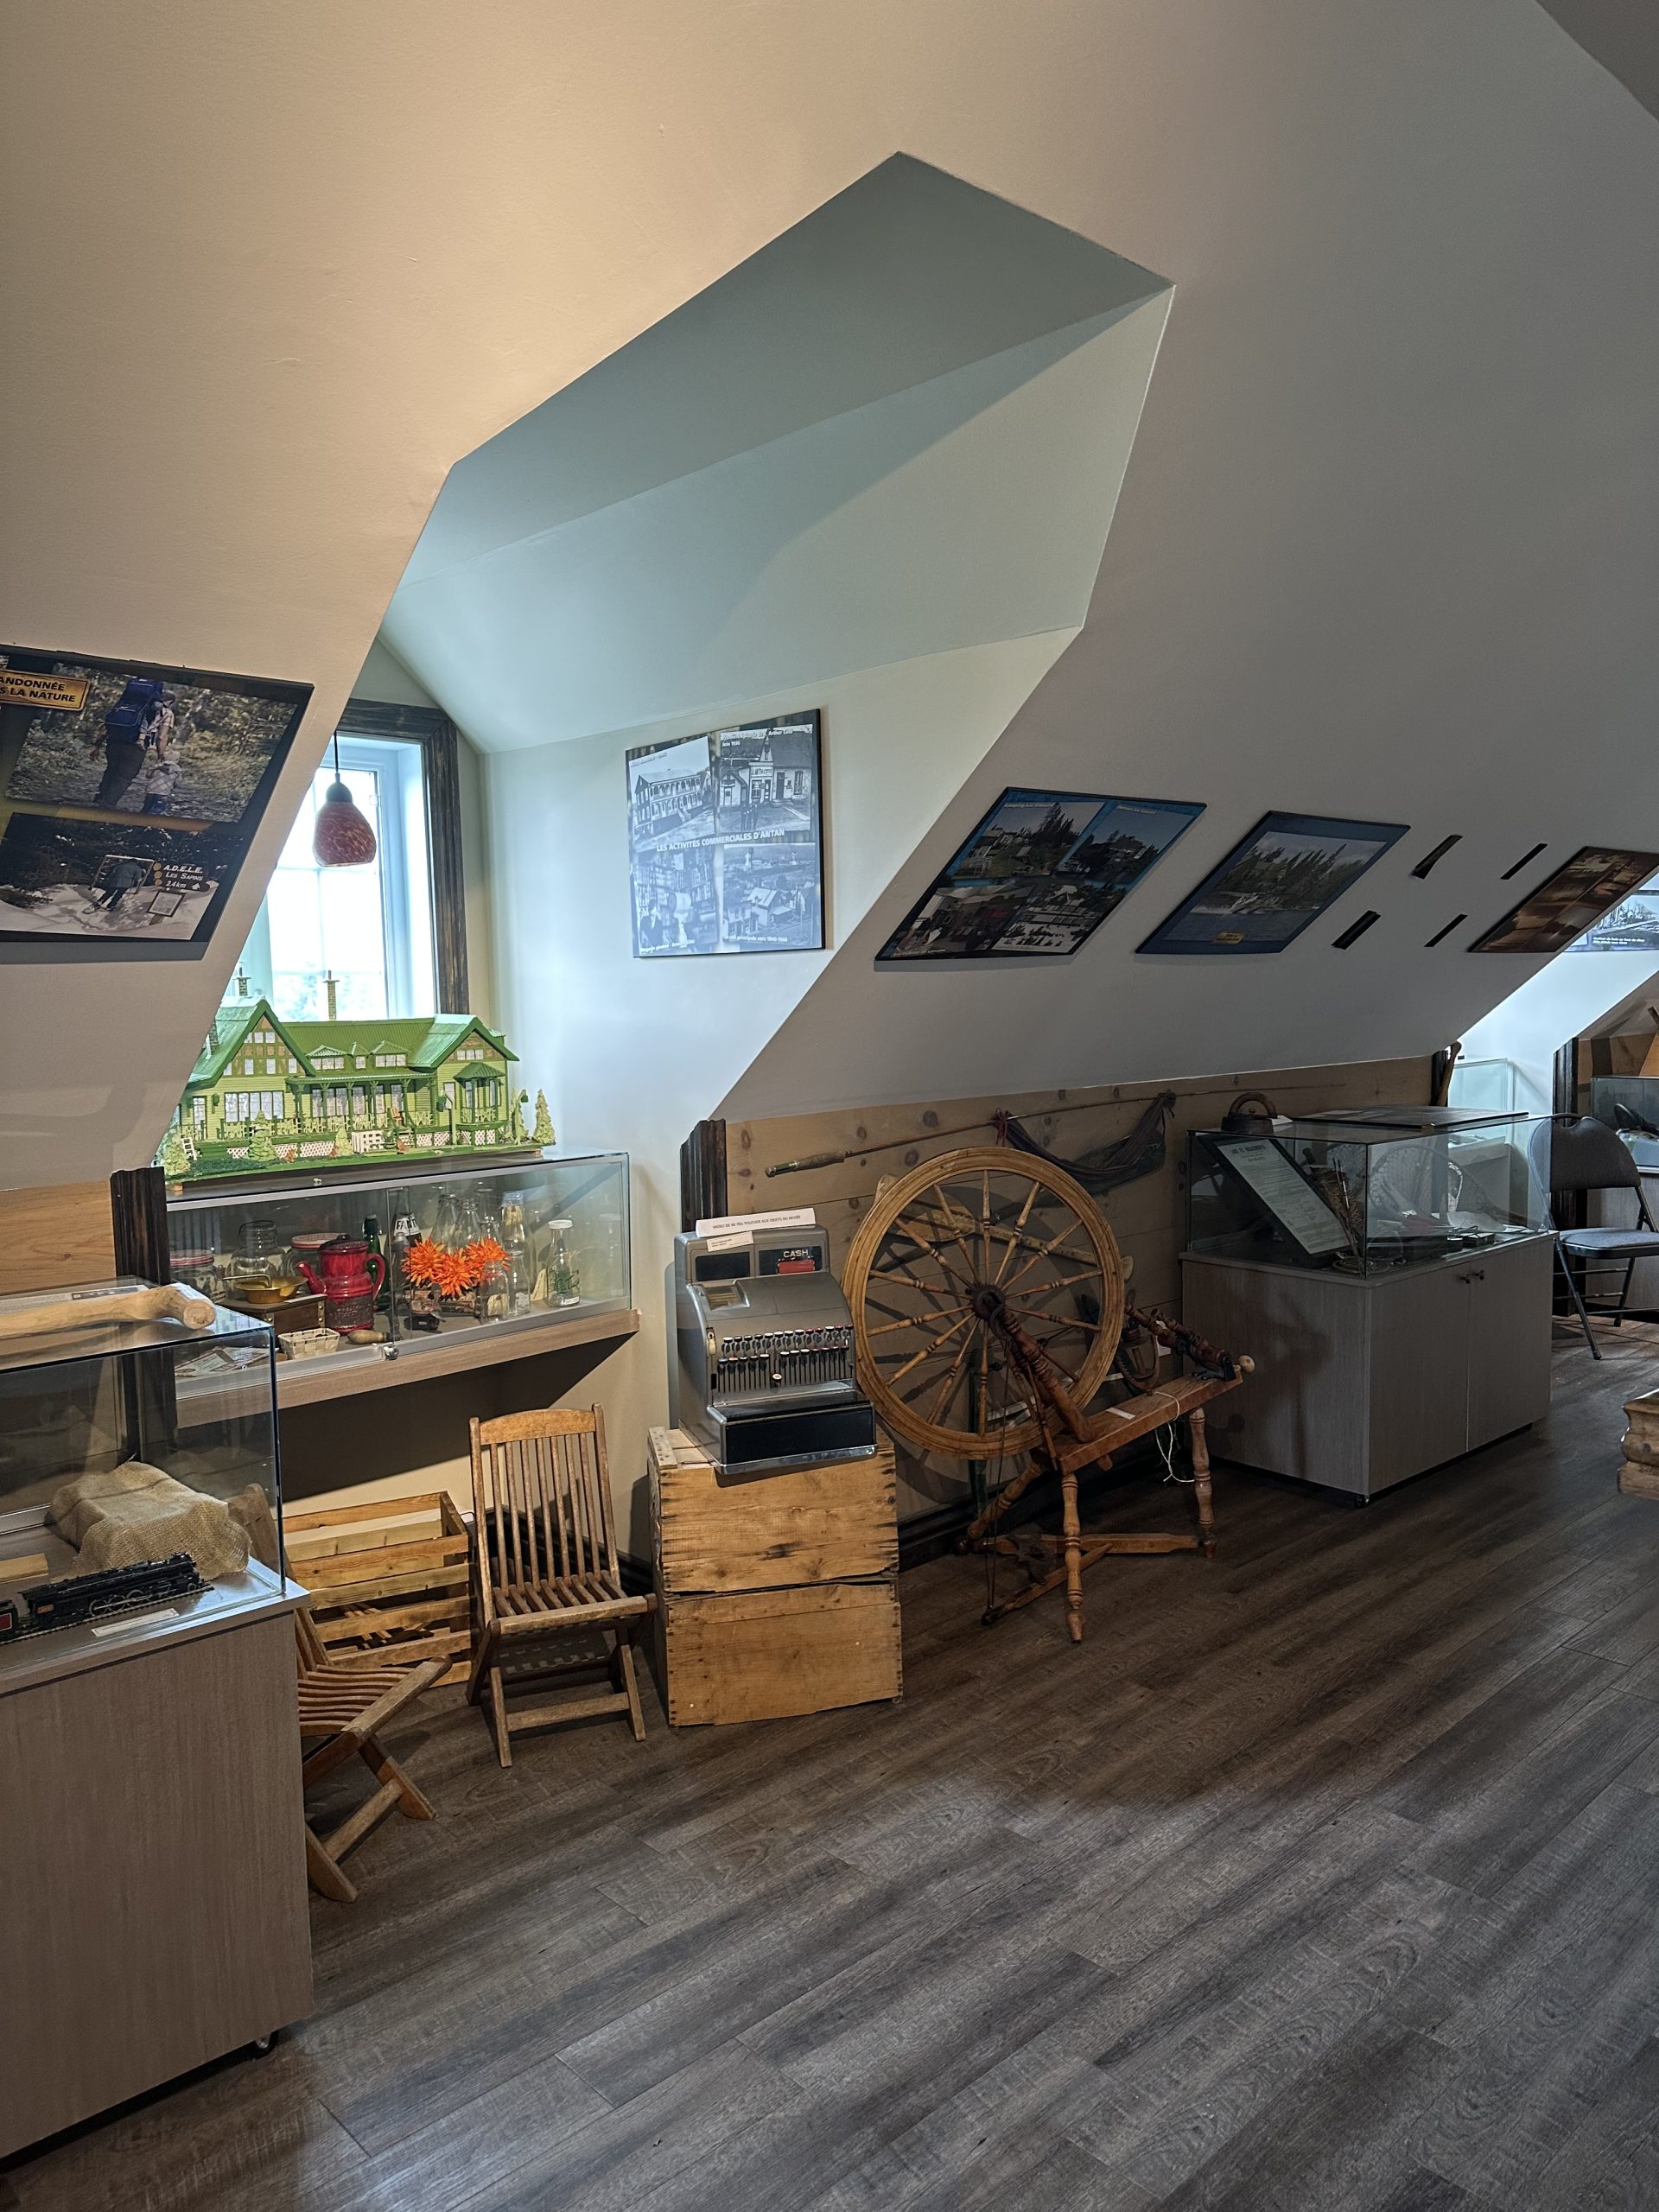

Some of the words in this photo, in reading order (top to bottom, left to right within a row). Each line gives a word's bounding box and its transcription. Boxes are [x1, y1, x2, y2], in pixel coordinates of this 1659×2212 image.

[10, 687, 25, 696] LA
[29, 690, 76, 702] NATURE
[701, 832, 752, 845] COMMERCIALES
[753, 828, 785, 840] D'ANTAN
[163, 865, 203, 874] A.D.E.L.E.
[396, 1217, 416, 1230] FANT
[783, 1249, 809, 1258] CASH
